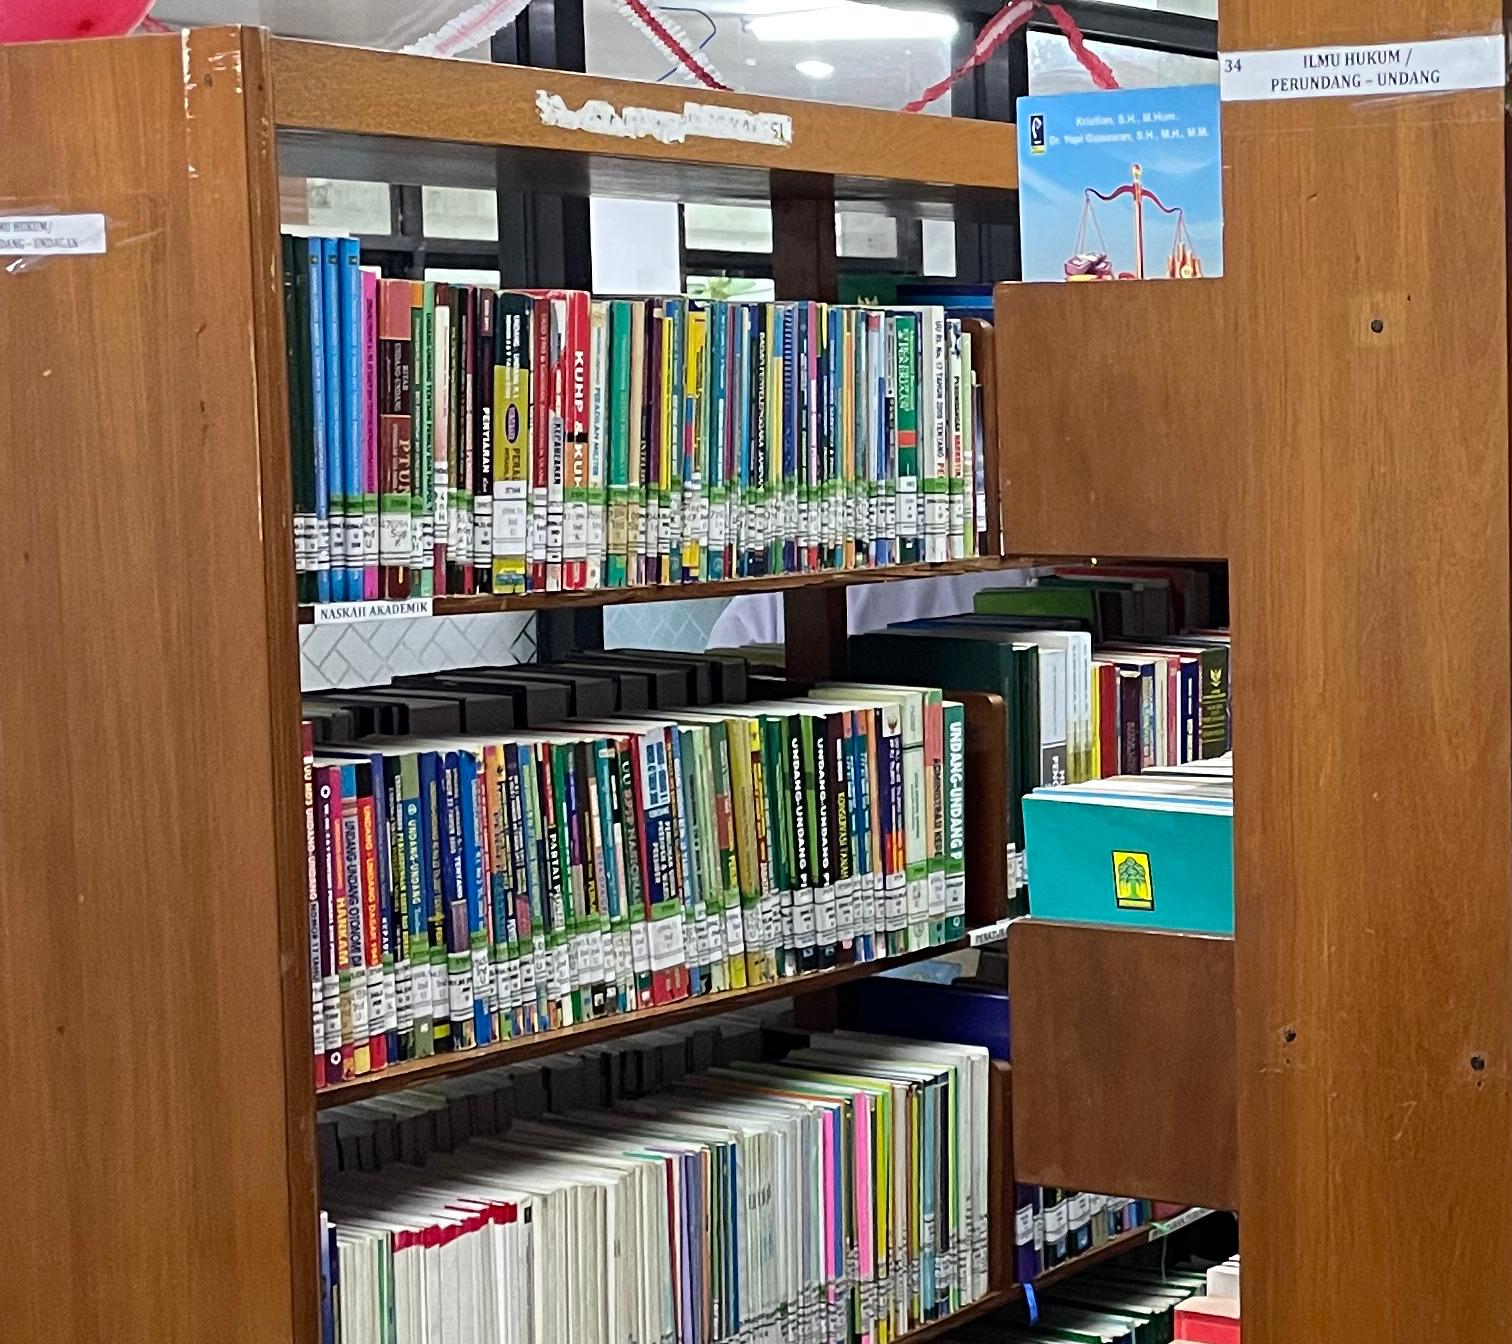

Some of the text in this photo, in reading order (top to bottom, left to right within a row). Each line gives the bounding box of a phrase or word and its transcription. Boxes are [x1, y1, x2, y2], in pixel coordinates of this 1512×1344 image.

[1225, 59, 1242, 73] 34
[1302, 51, 1340, 69] ILMU
[1344, 49, 1400, 67] HUKUM
[1270, 74, 1361, 92] PERUNDANG
[1377, 69, 1441, 87] UNDANG
[574, 351, 584, 413] KUHP
[482, 407, 491, 473] PENYIARAN
[574, 420, 584, 436] &
[369, 602, 428, 617] AKADEMIK
[792, 737, 807, 870] UNDANG-UNDANG
[817, 737, 830, 869] UNDANG-UNDANG
[949, 721, 963, 847] UNDANG-UNDANG
[363, 805, 374, 851] UNDANG
[344, 820, 359, 906] UNDANG-UNDANG
[366, 857, 376, 903] UNDANG
[408, 819, 421, 905] UNDANG-UNDANG
[549, 833, 561, 880] PARTAI
[337, 897, 349, 966] HANKAM
[368, 904, 377, 940] DASAR
